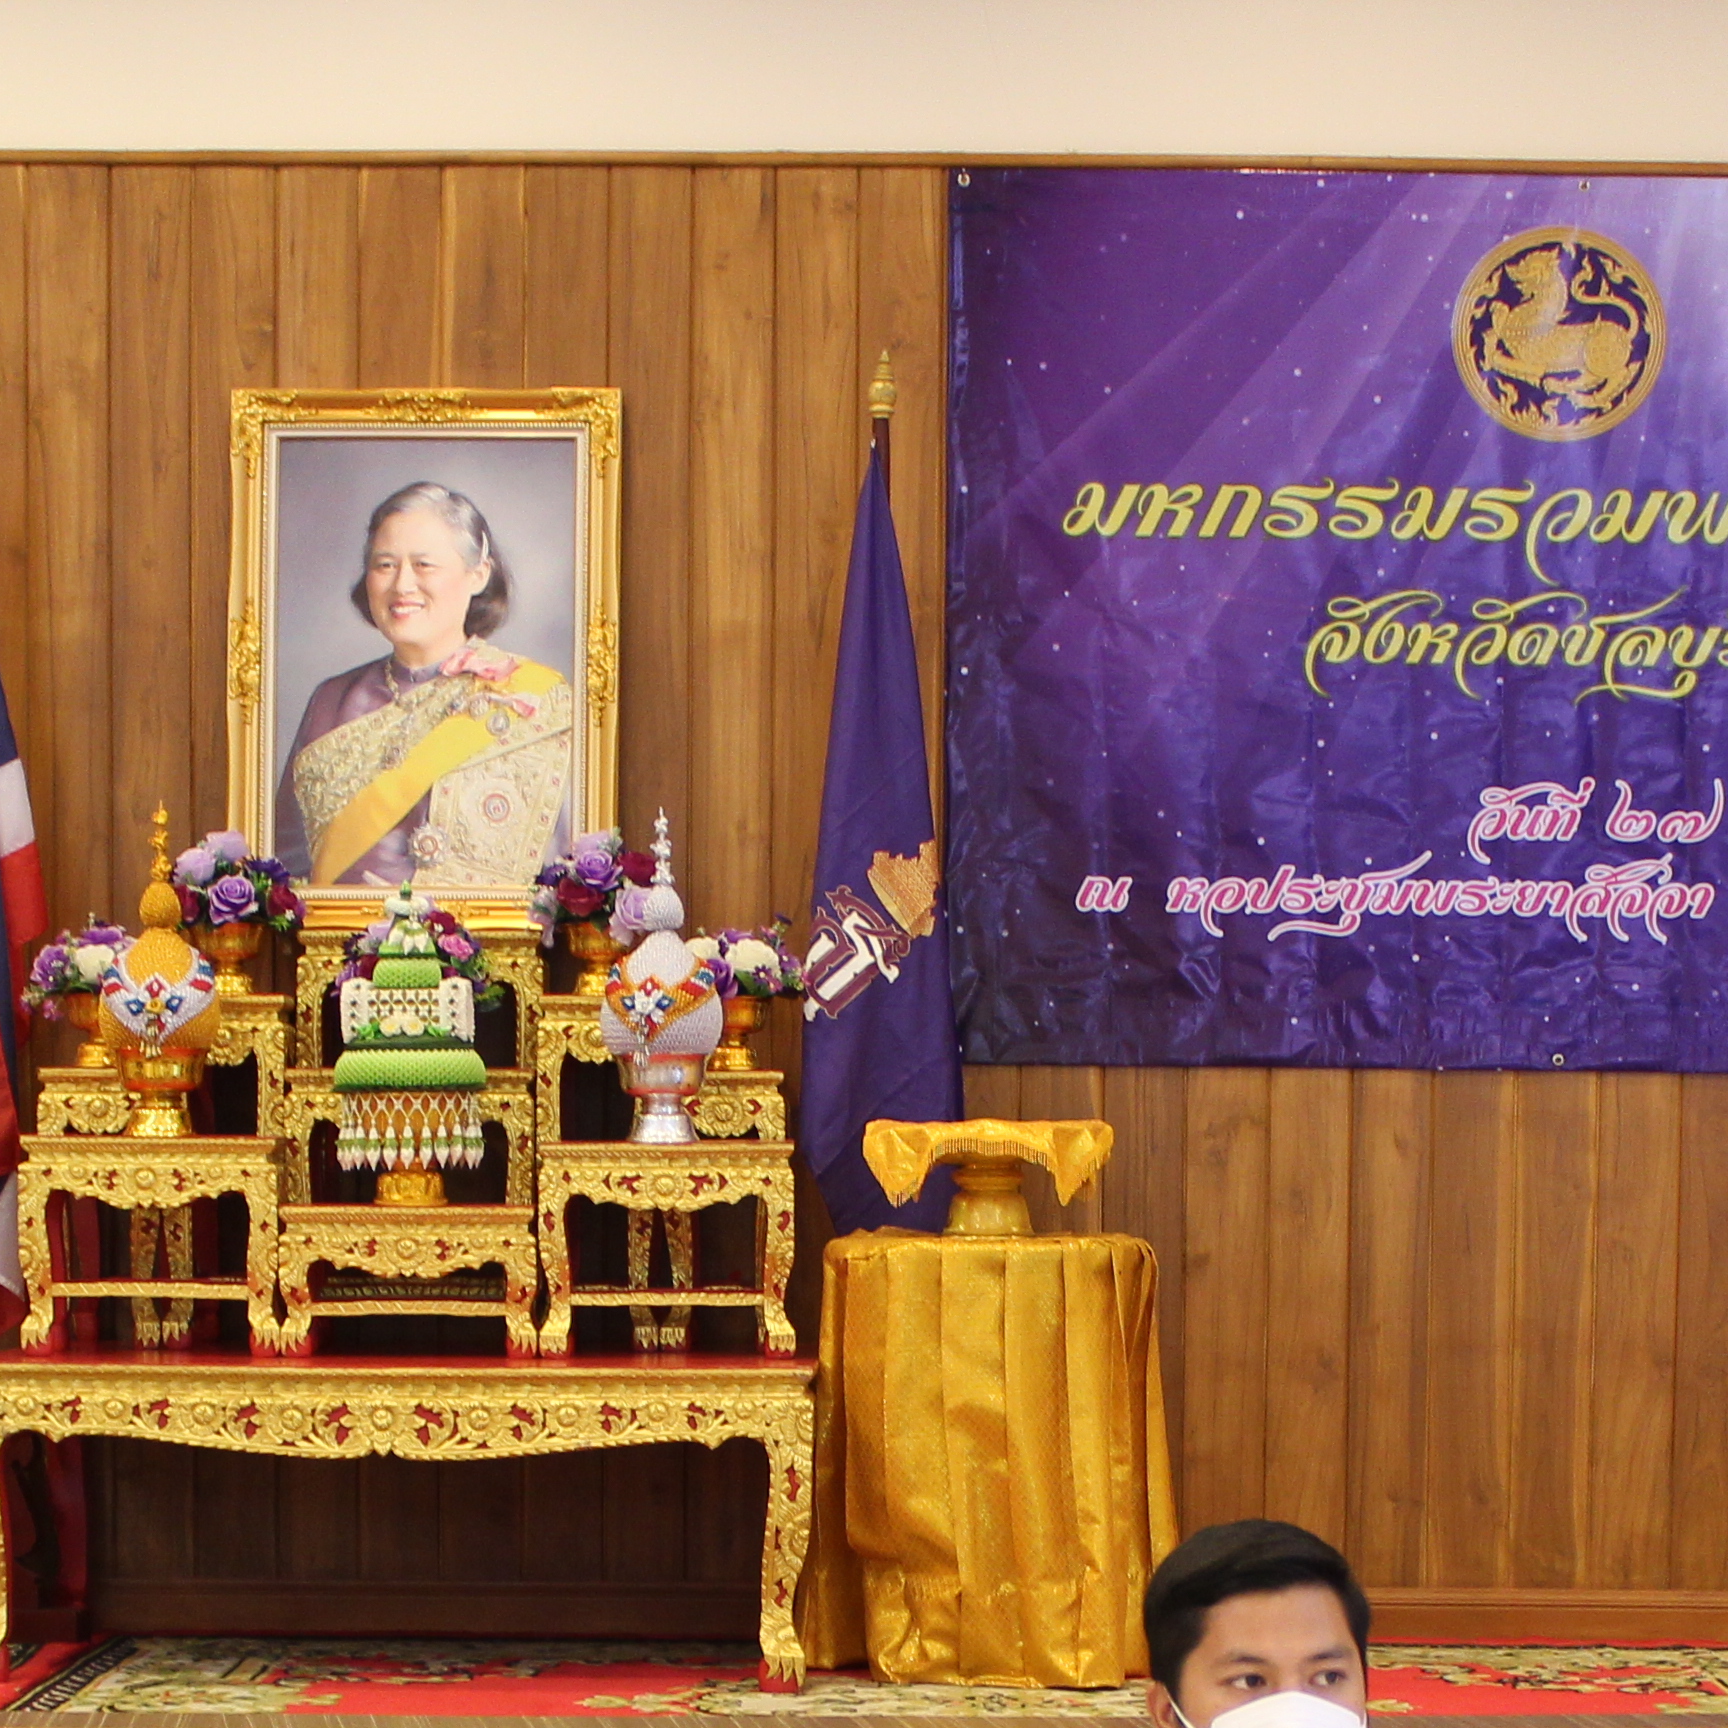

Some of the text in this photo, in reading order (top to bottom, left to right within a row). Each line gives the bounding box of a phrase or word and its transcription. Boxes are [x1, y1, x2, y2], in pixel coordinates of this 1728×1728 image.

[1467, 777, 1596, 864] วันที่
[1604, 778, 1725, 843] ๒๗
[1075, 874, 1134, 914] ณ
[1165, 851, 1716, 945] หอประชุมพระยาสัจจา
